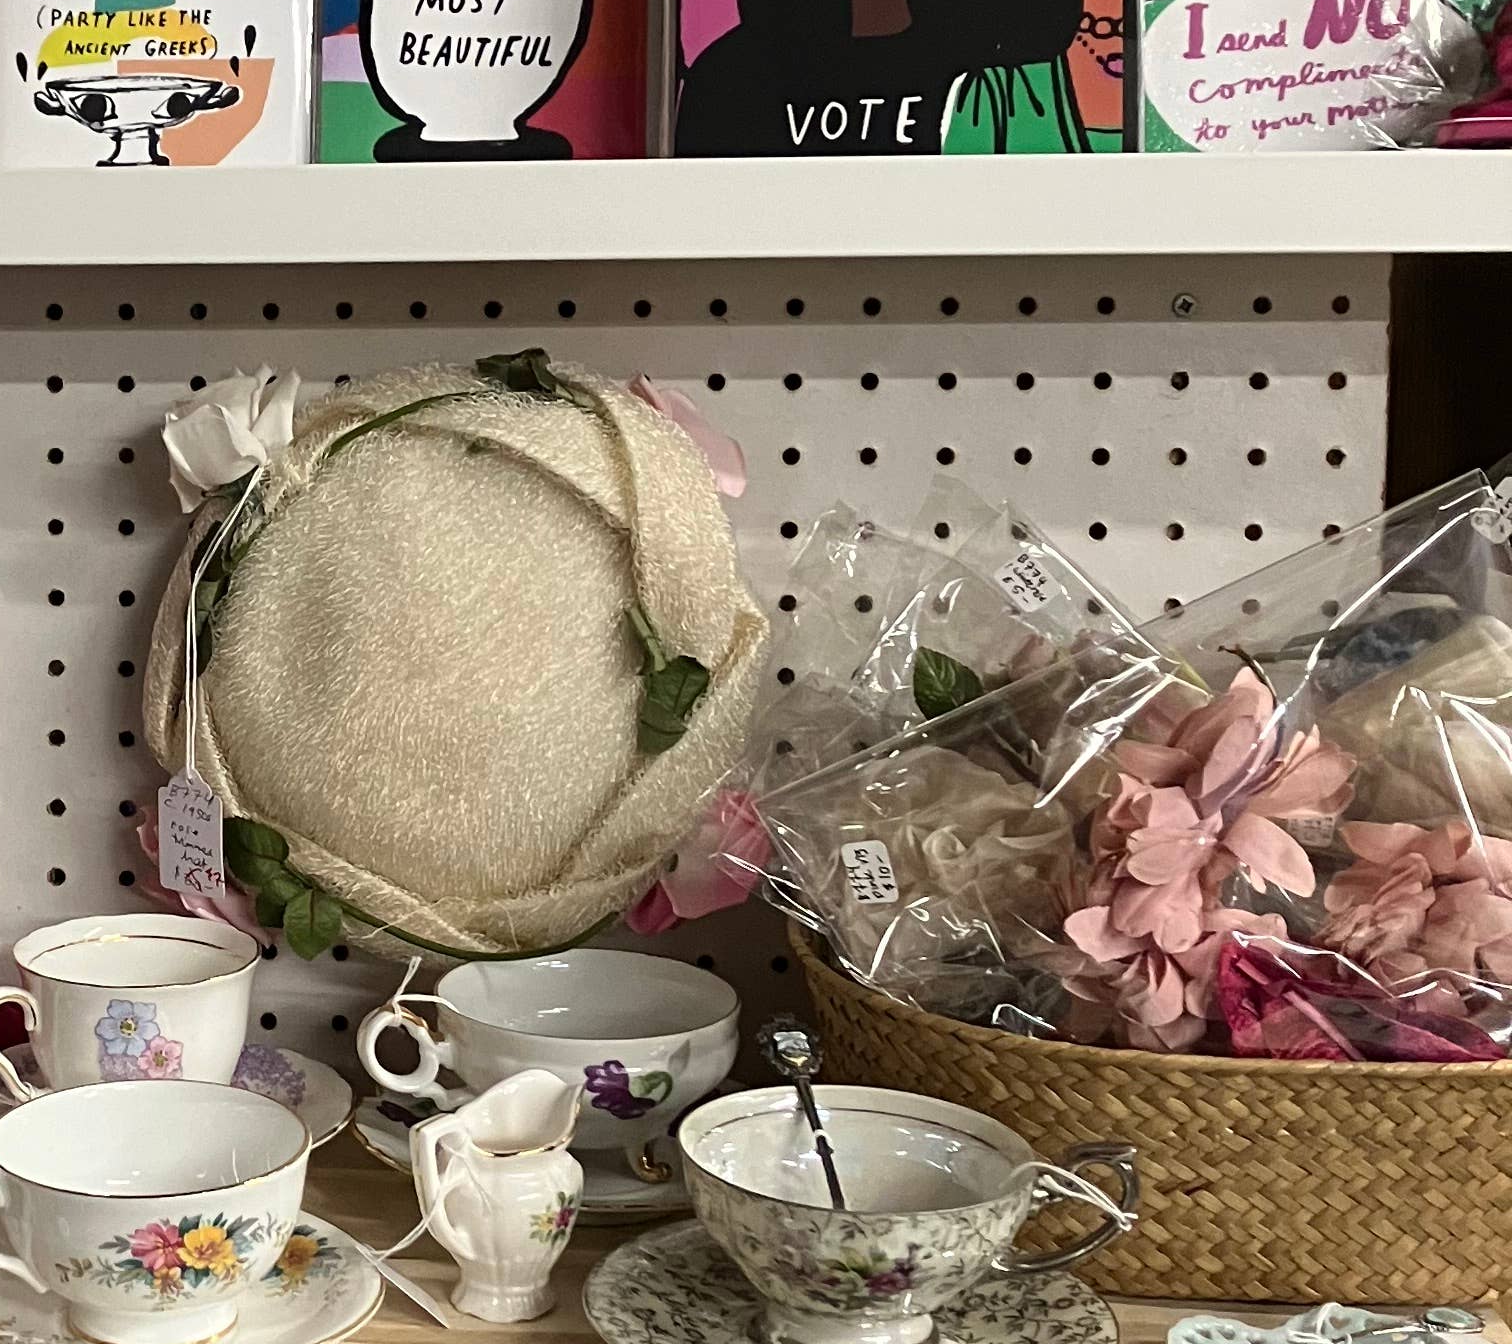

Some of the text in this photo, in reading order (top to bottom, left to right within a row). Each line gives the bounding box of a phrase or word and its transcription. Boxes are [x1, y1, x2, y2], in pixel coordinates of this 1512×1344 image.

[36, 5, 213, 29] (PARTY LIKE THE
[1183, 1, 1209, 60] I
[1216, 19, 1288, 54] send
[64, 33, 220, 61] ANCIENT GREEKS)
[398, 31, 553, 68] BEAUTIFUL
[786, 95, 924, 146] VOTE
[1194, 117, 1232, 144] to
[1251, 111, 1317, 140] your
